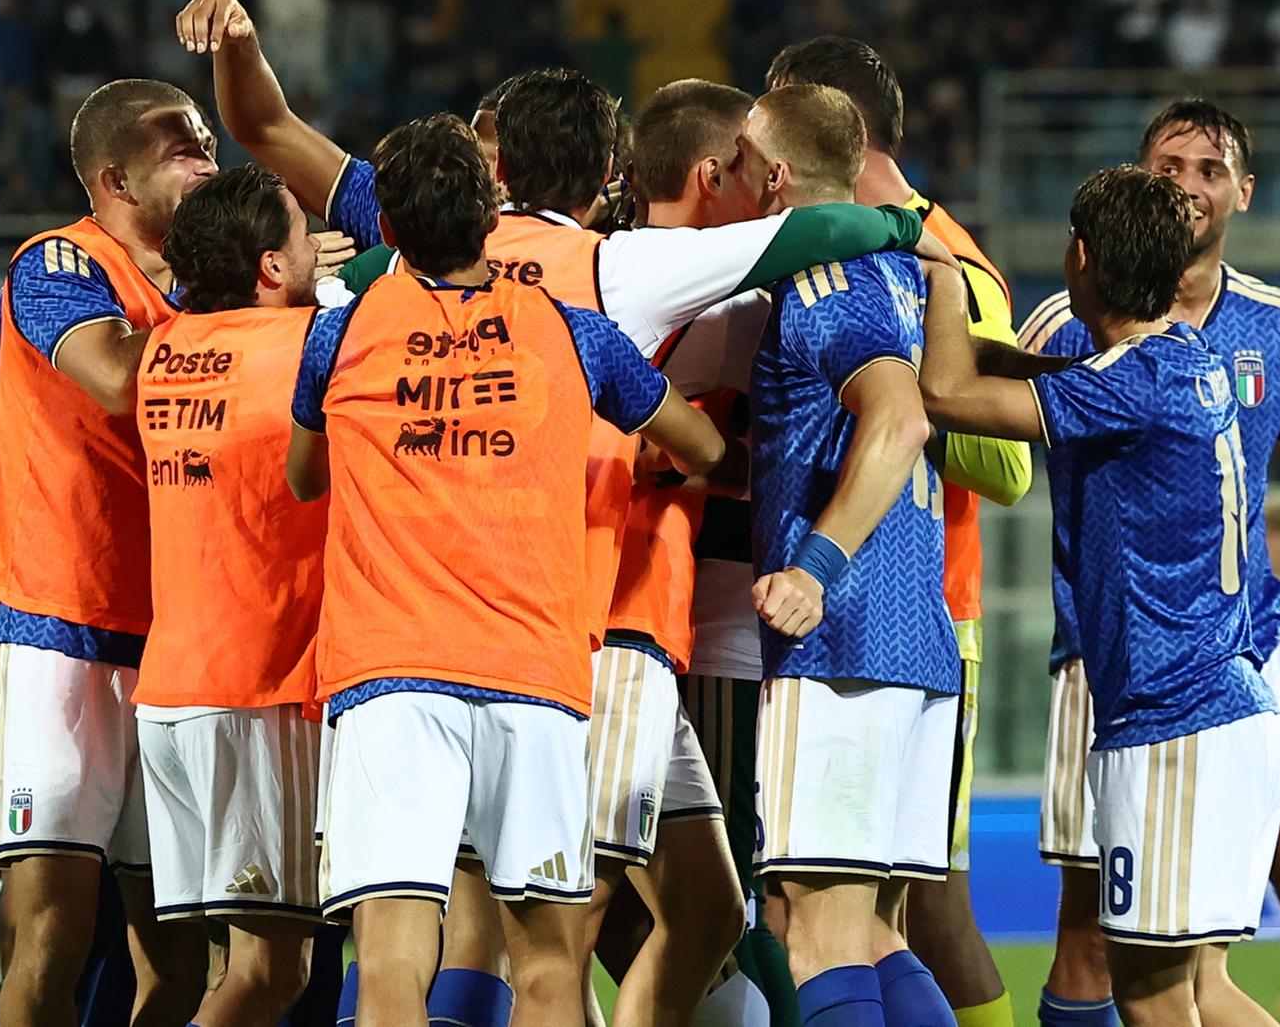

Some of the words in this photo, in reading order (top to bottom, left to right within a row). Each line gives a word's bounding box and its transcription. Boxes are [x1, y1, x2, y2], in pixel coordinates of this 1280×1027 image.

[486, 259, 543, 286] ste
[147, 343, 232, 374] Poste
[175, 399, 227, 431] TIM
[151, 450, 179, 485] eni
